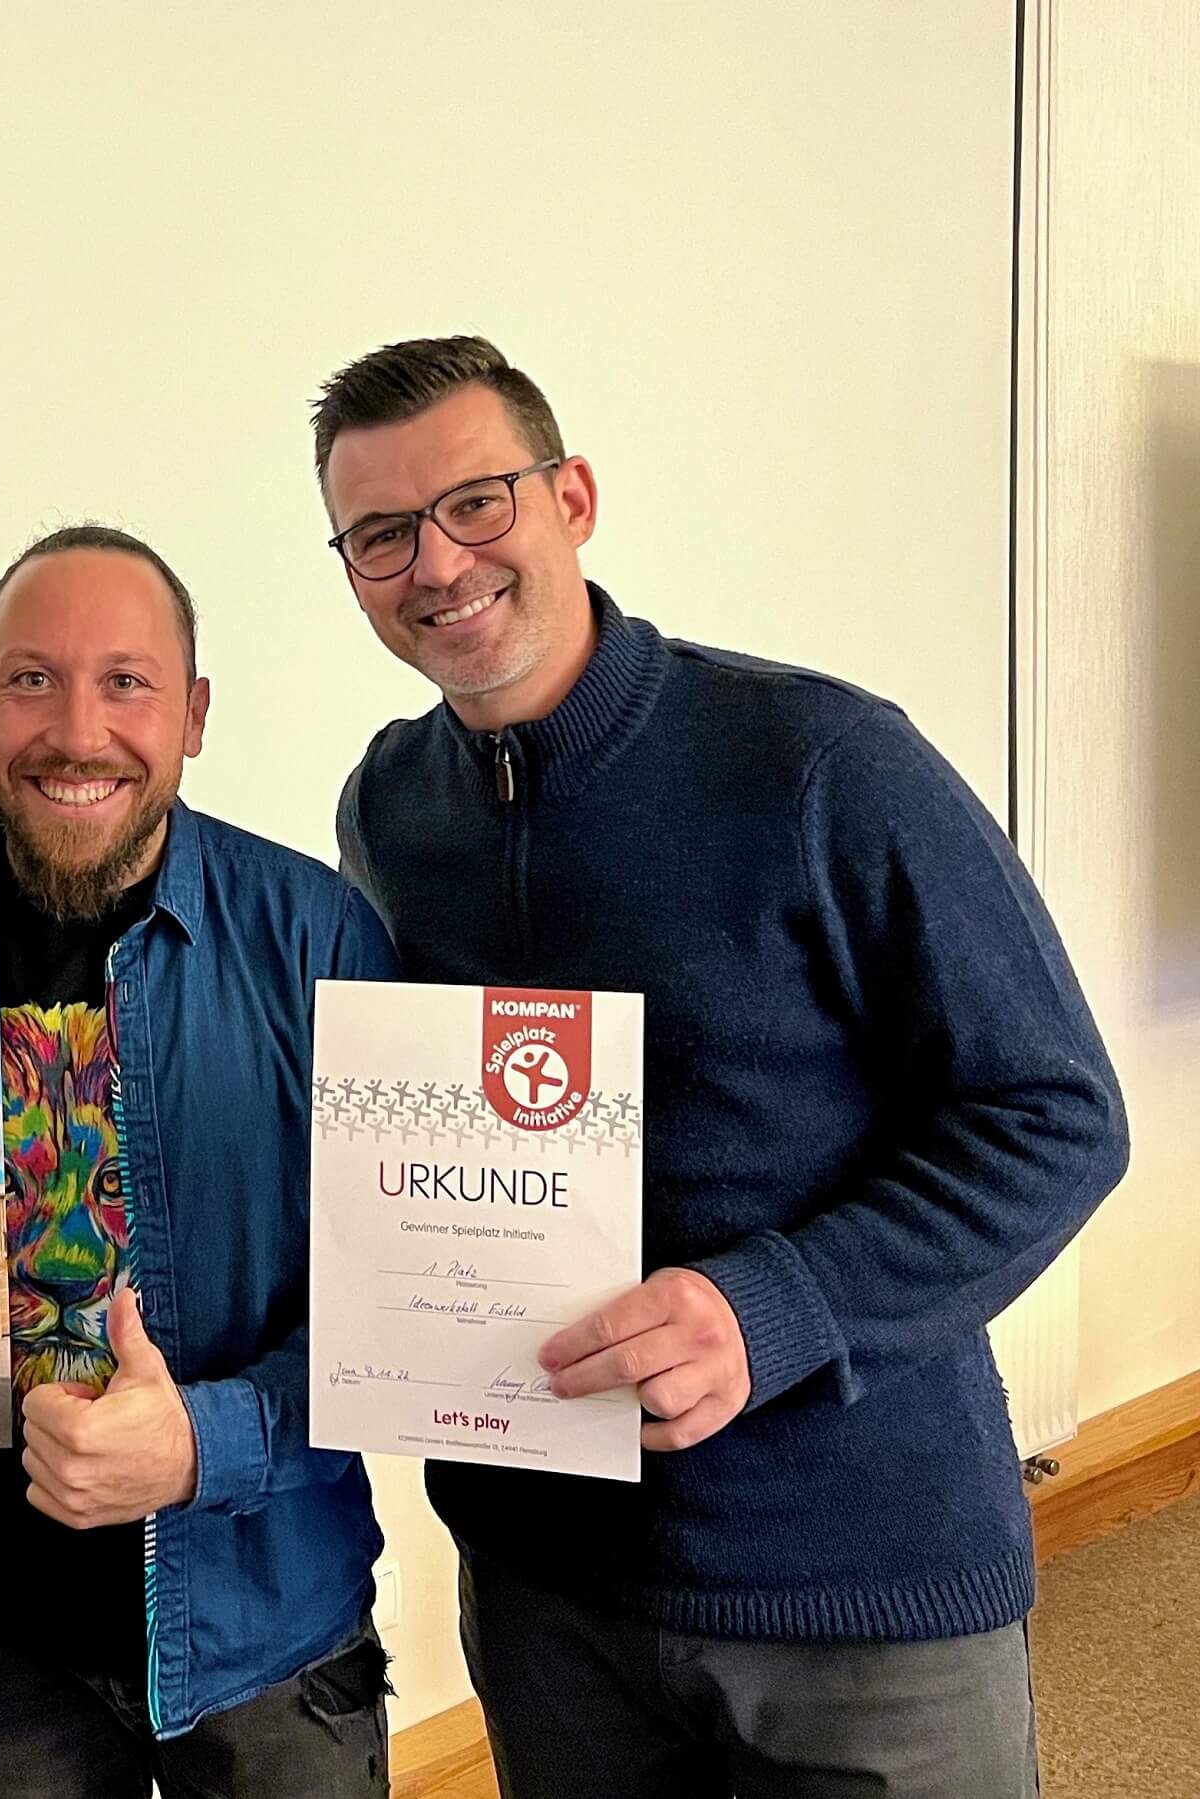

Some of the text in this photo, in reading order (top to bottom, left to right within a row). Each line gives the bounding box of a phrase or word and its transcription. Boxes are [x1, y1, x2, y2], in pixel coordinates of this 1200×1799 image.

[491, 1000, 576, 1019] KOMPAN
[485, 1025, 557, 1075] Spielplatz
[513, 1091, 582, 1127] Initiative
[379, 1161, 569, 1208] URKUNDE
[400, 1220, 545, 1241] Gewinner Spielplatz Initiative
[434, 1409, 510, 1435] Let's play
